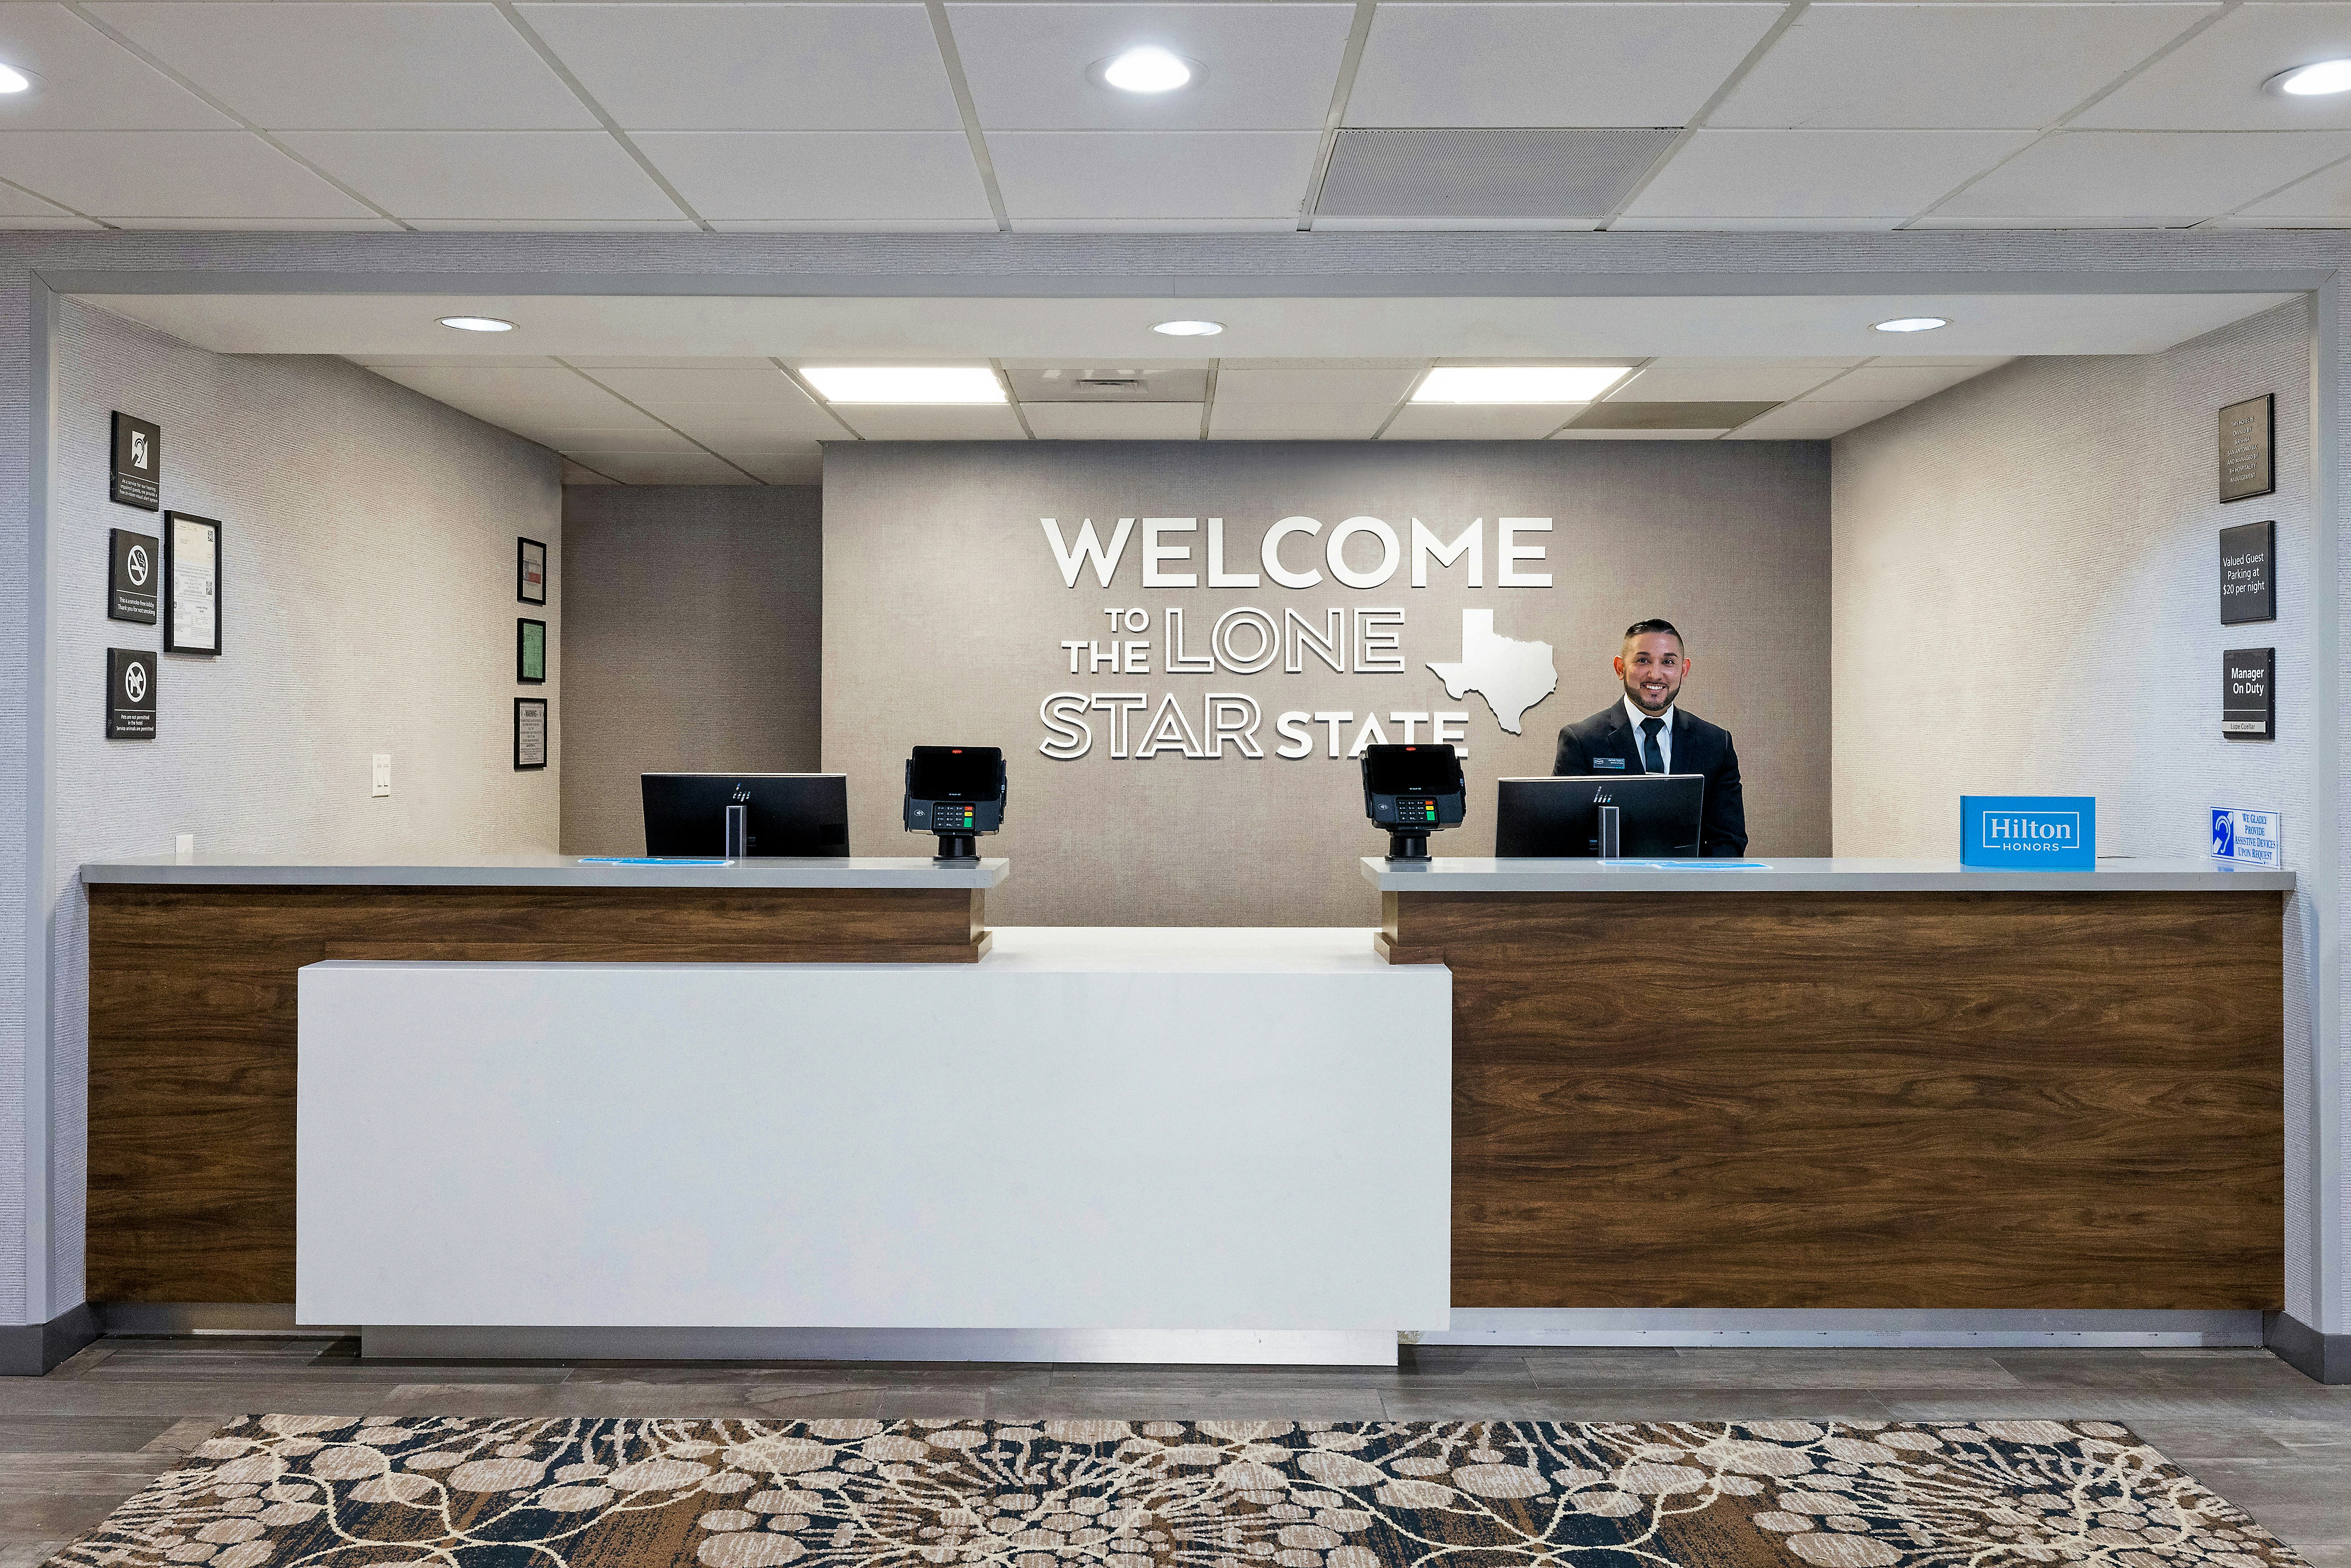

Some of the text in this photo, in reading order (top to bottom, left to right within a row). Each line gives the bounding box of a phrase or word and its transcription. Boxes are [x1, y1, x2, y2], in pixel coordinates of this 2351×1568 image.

[2235, 437, 2250, 445] KRISHNA
[2235, 446, 2251, 454] ANTONIO
[2235, 454, 2253, 463] MANAGED
[2235, 463, 2257, 472] HOSPITALITY
[2231, 472, 2256, 483] MANAGEMENT
[1040, 516, 1553, 589] WELCOME
[2223, 552, 2264, 567] Valued Guest
[2228, 568, 2259, 580] Parking at
[2223, 581, 2265, 595] $20 per night
[1104, 608, 1149, 632] TO
[1061, 606, 1405, 673] THE LONE
[2231, 668, 2264, 681] Manager
[2233, 682, 2264, 697] On Duty
[1039, 692, 1469, 759] STAR STATE
[2242, 813, 2267, 824] WE GLADLY
[1991, 819, 2071, 838] Hilton
[2245, 825, 2265, 836] PROVIDE
[2235, 836, 2275, 848] ASSISTIVE DEVICES
[2238, 847, 2272, 860] UPON REQUEST
